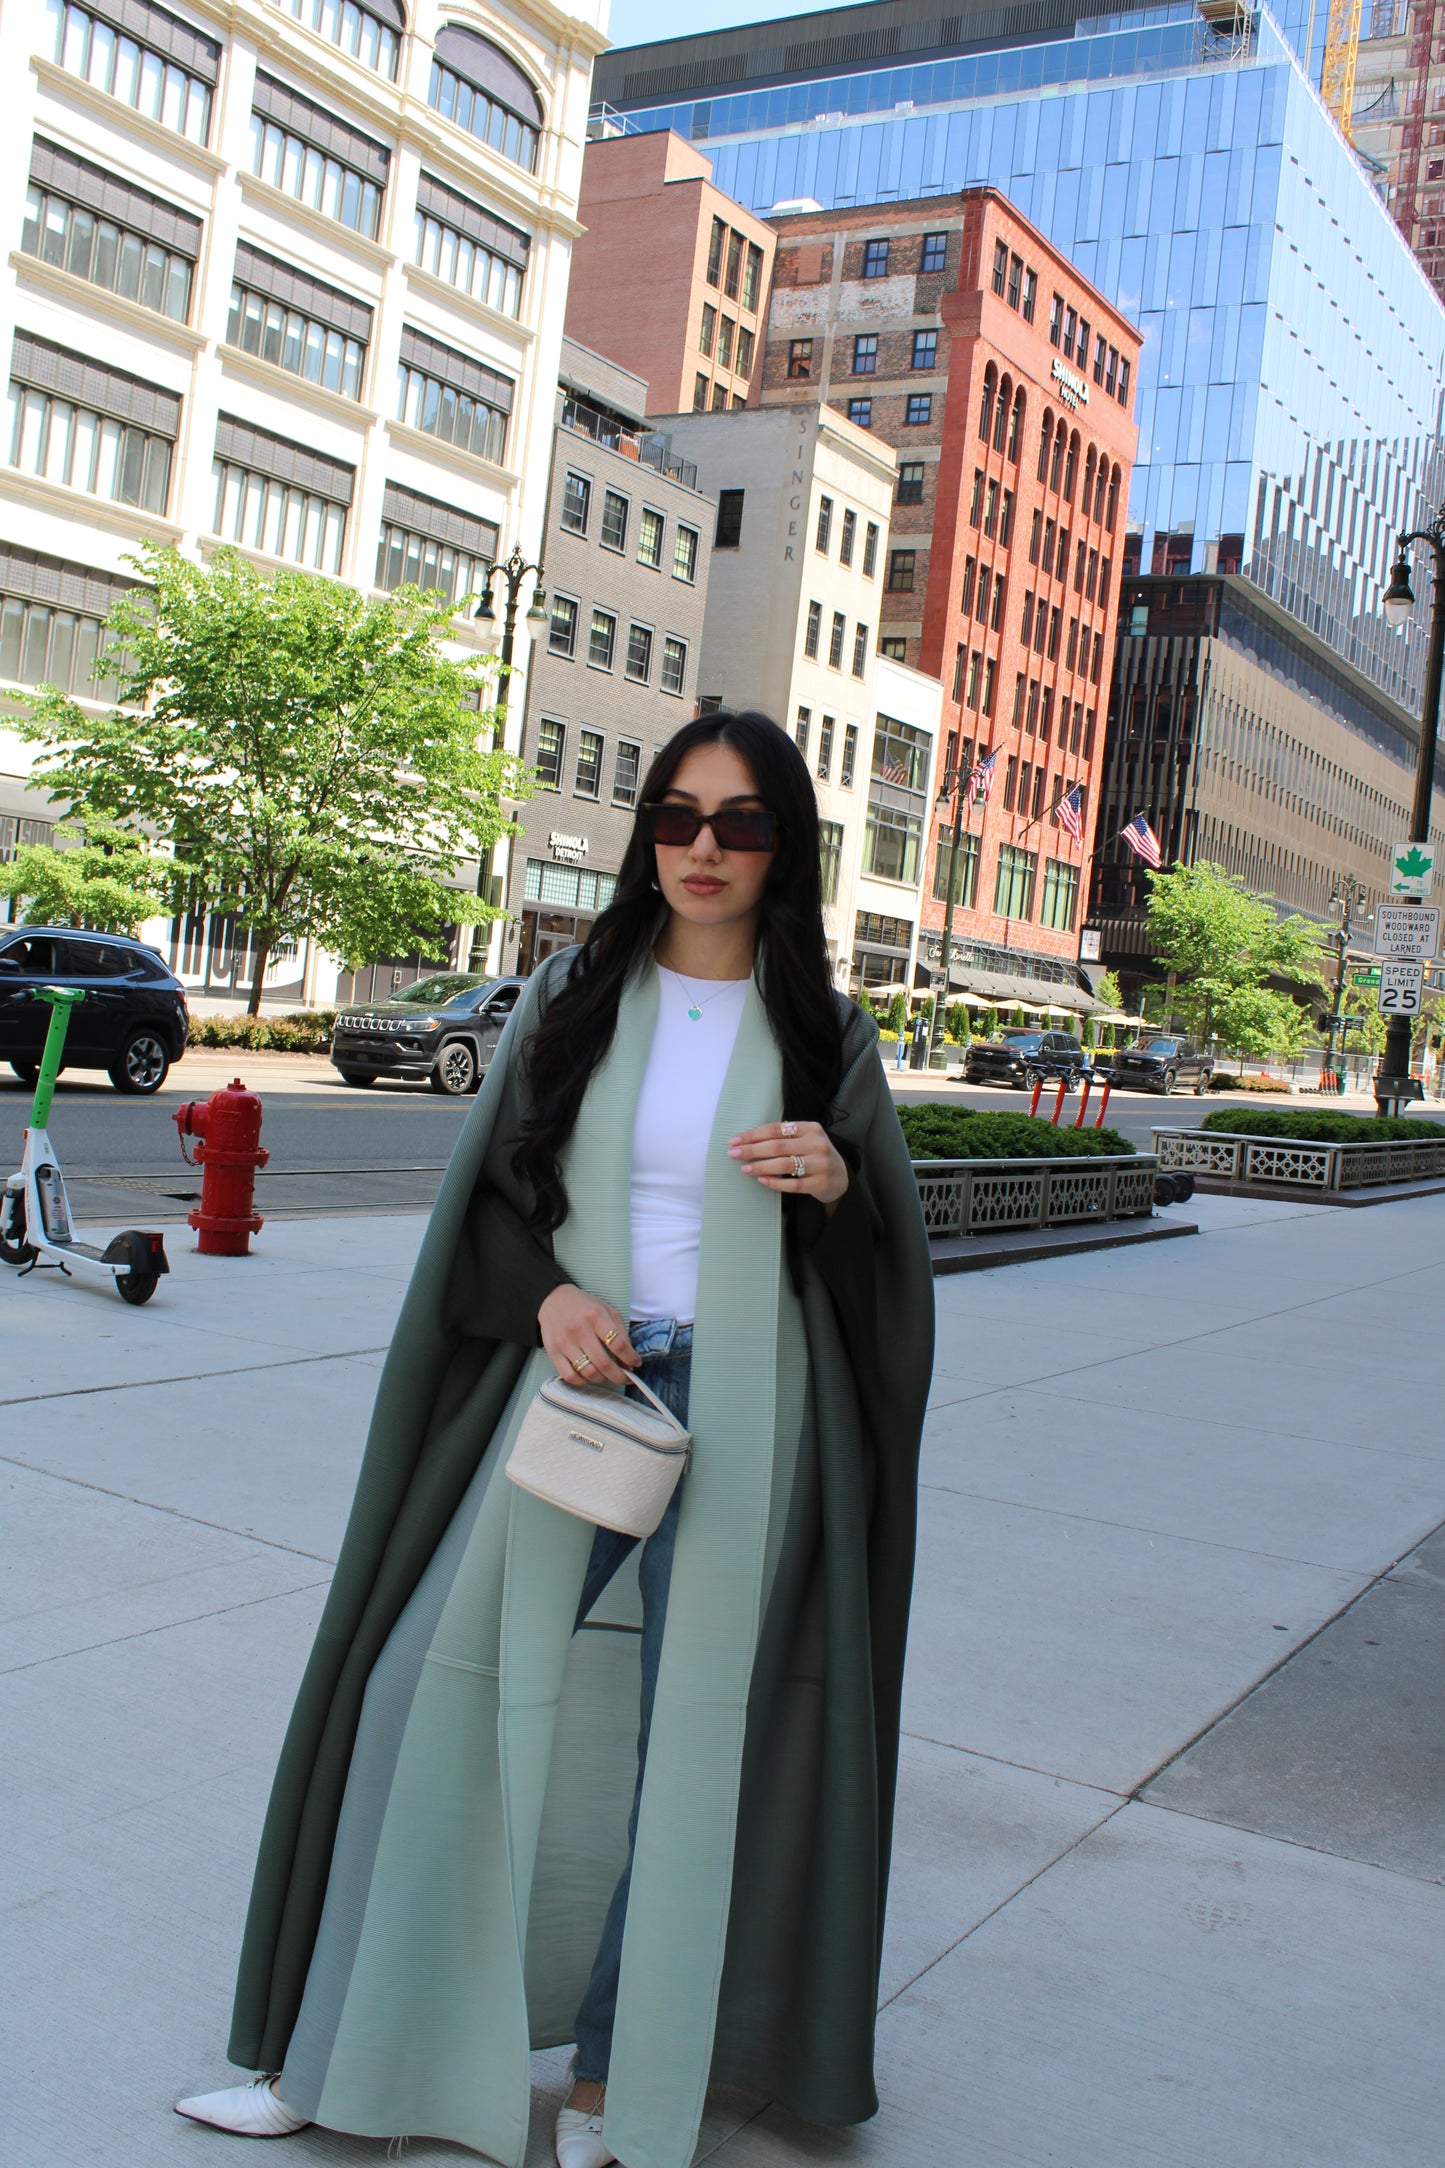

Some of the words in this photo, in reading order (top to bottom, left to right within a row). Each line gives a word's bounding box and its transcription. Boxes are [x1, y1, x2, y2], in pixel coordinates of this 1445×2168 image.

[1051, 357, 1089, 405] SHINOLA
[1061, 386, 1079, 408] HOTEL
[784, 419, 808, 561] SINGER
[550, 831, 588, 852] SHINOLA
[555, 849, 583, 860] DETROIT
[1381, 910, 1436, 921] SOUTHBOUND
[1385, 922, 1430, 932] WOODWARD
[1382, 932, 1414, 942] CLOSED
[1420, 934, 1430, 943] AT
[1390, 944, 1422, 953] LARNED
[1385, 966, 1421, 977] SPEED
[1387, 978, 1415, 987] LIMIT
[1382, 988, 1417, 1009] 25
